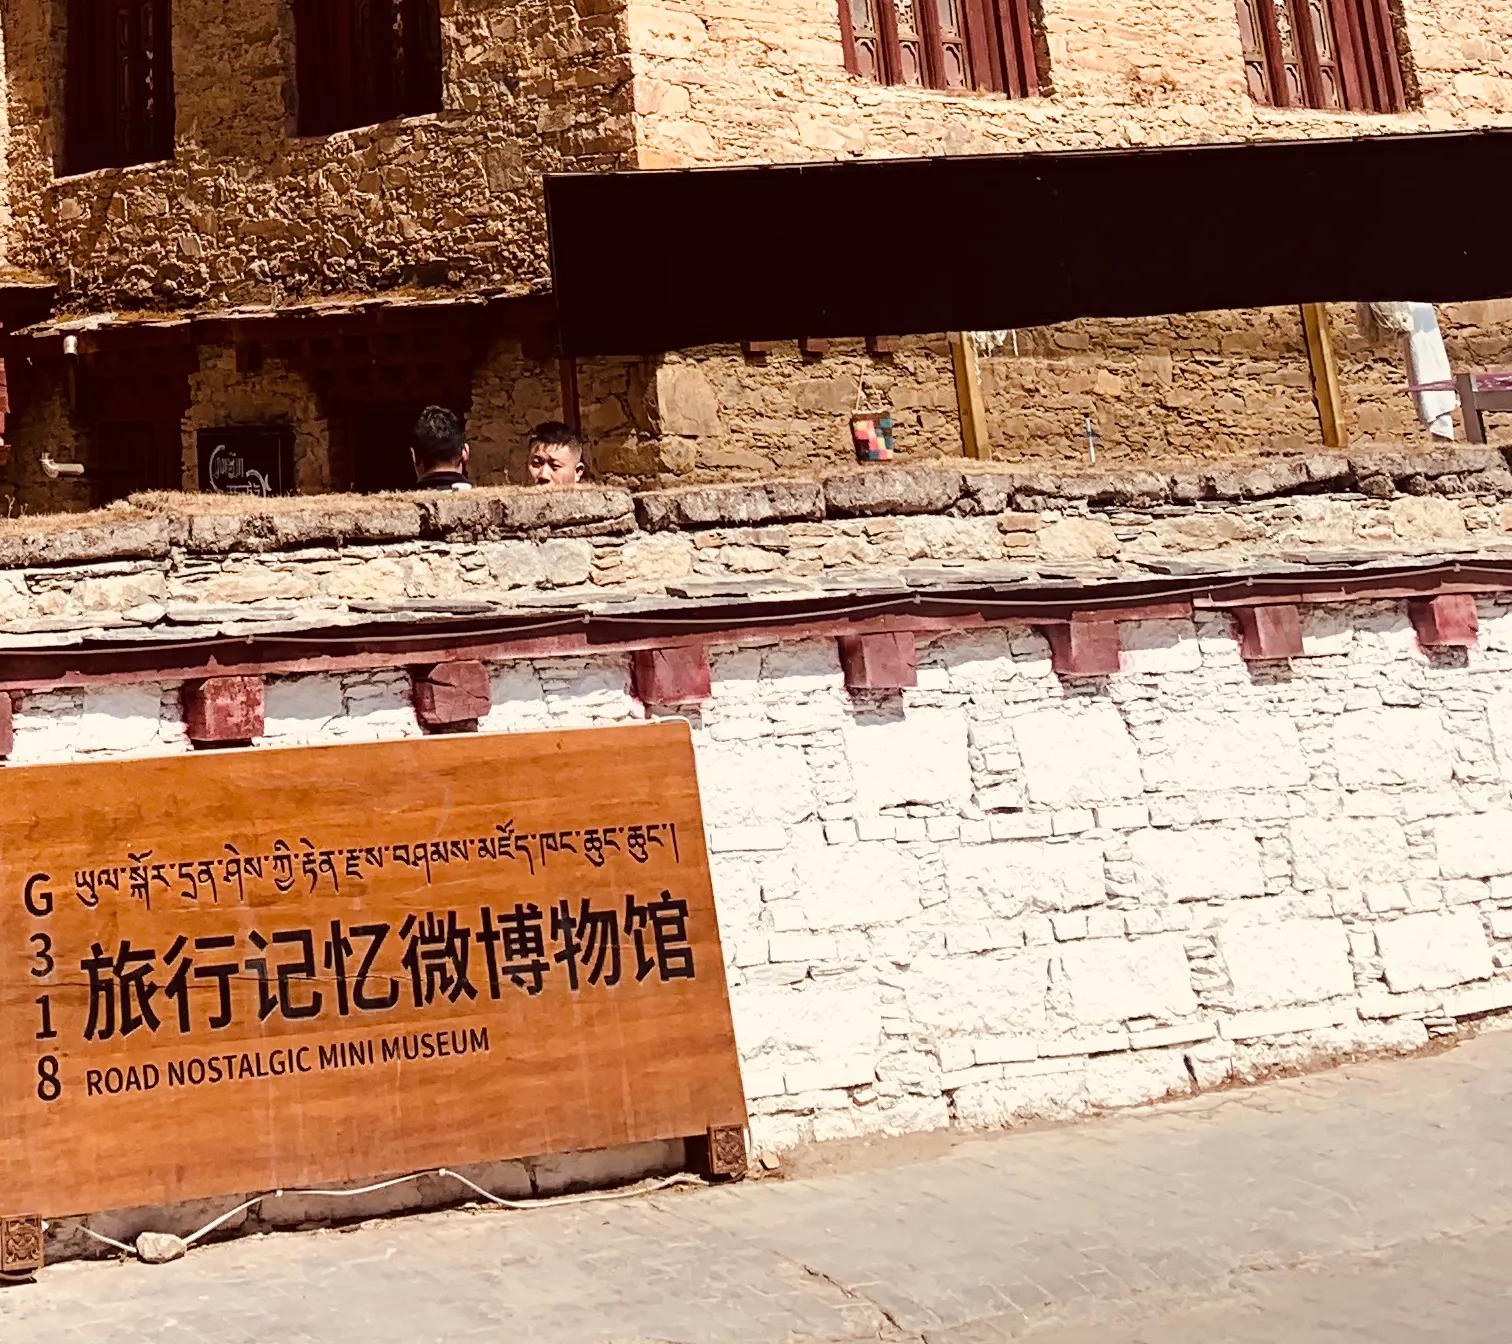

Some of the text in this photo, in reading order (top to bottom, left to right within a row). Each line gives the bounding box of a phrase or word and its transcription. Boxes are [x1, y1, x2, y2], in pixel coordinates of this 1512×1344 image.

[24, 872, 62, 1101] G318
[80, 890, 696, 1041] 旅行记忆微博物馆
[87, 1027, 489, 1096] ROAD NOSTALGIC MINI MUSEUM
